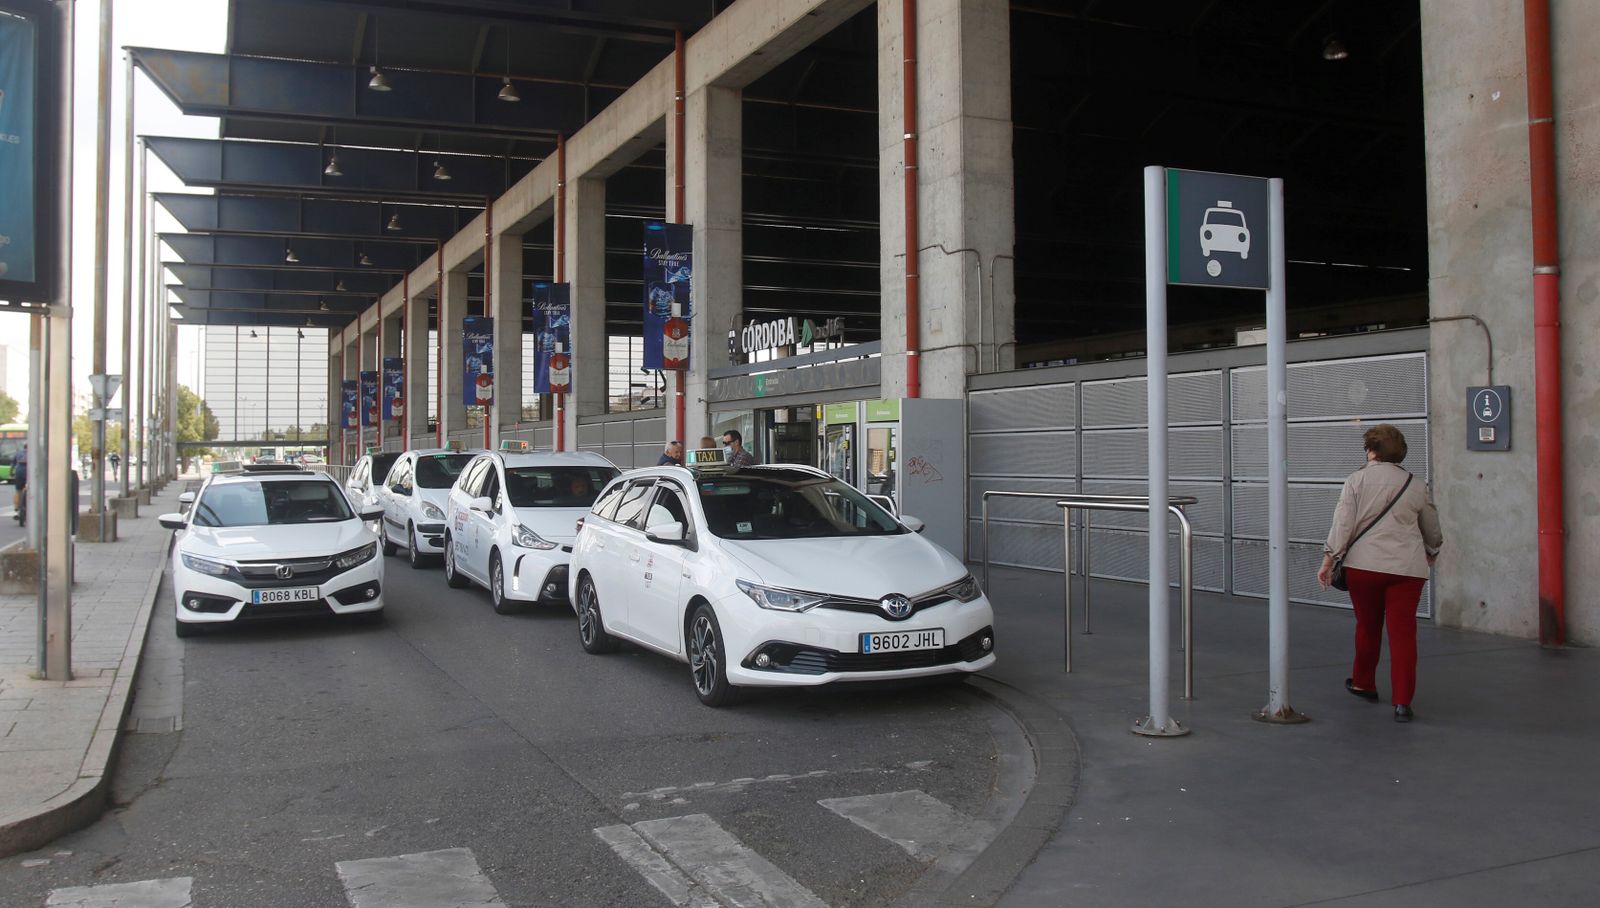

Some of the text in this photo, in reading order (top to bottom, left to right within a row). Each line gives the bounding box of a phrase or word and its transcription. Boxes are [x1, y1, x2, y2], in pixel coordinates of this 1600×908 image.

[741, 316, 795, 354] CÓRDOBA
[696, 450, 717, 462] TAXI
[261, 589, 315, 602] 8068 KBL
[872, 632, 940, 650] 9602 JHL
